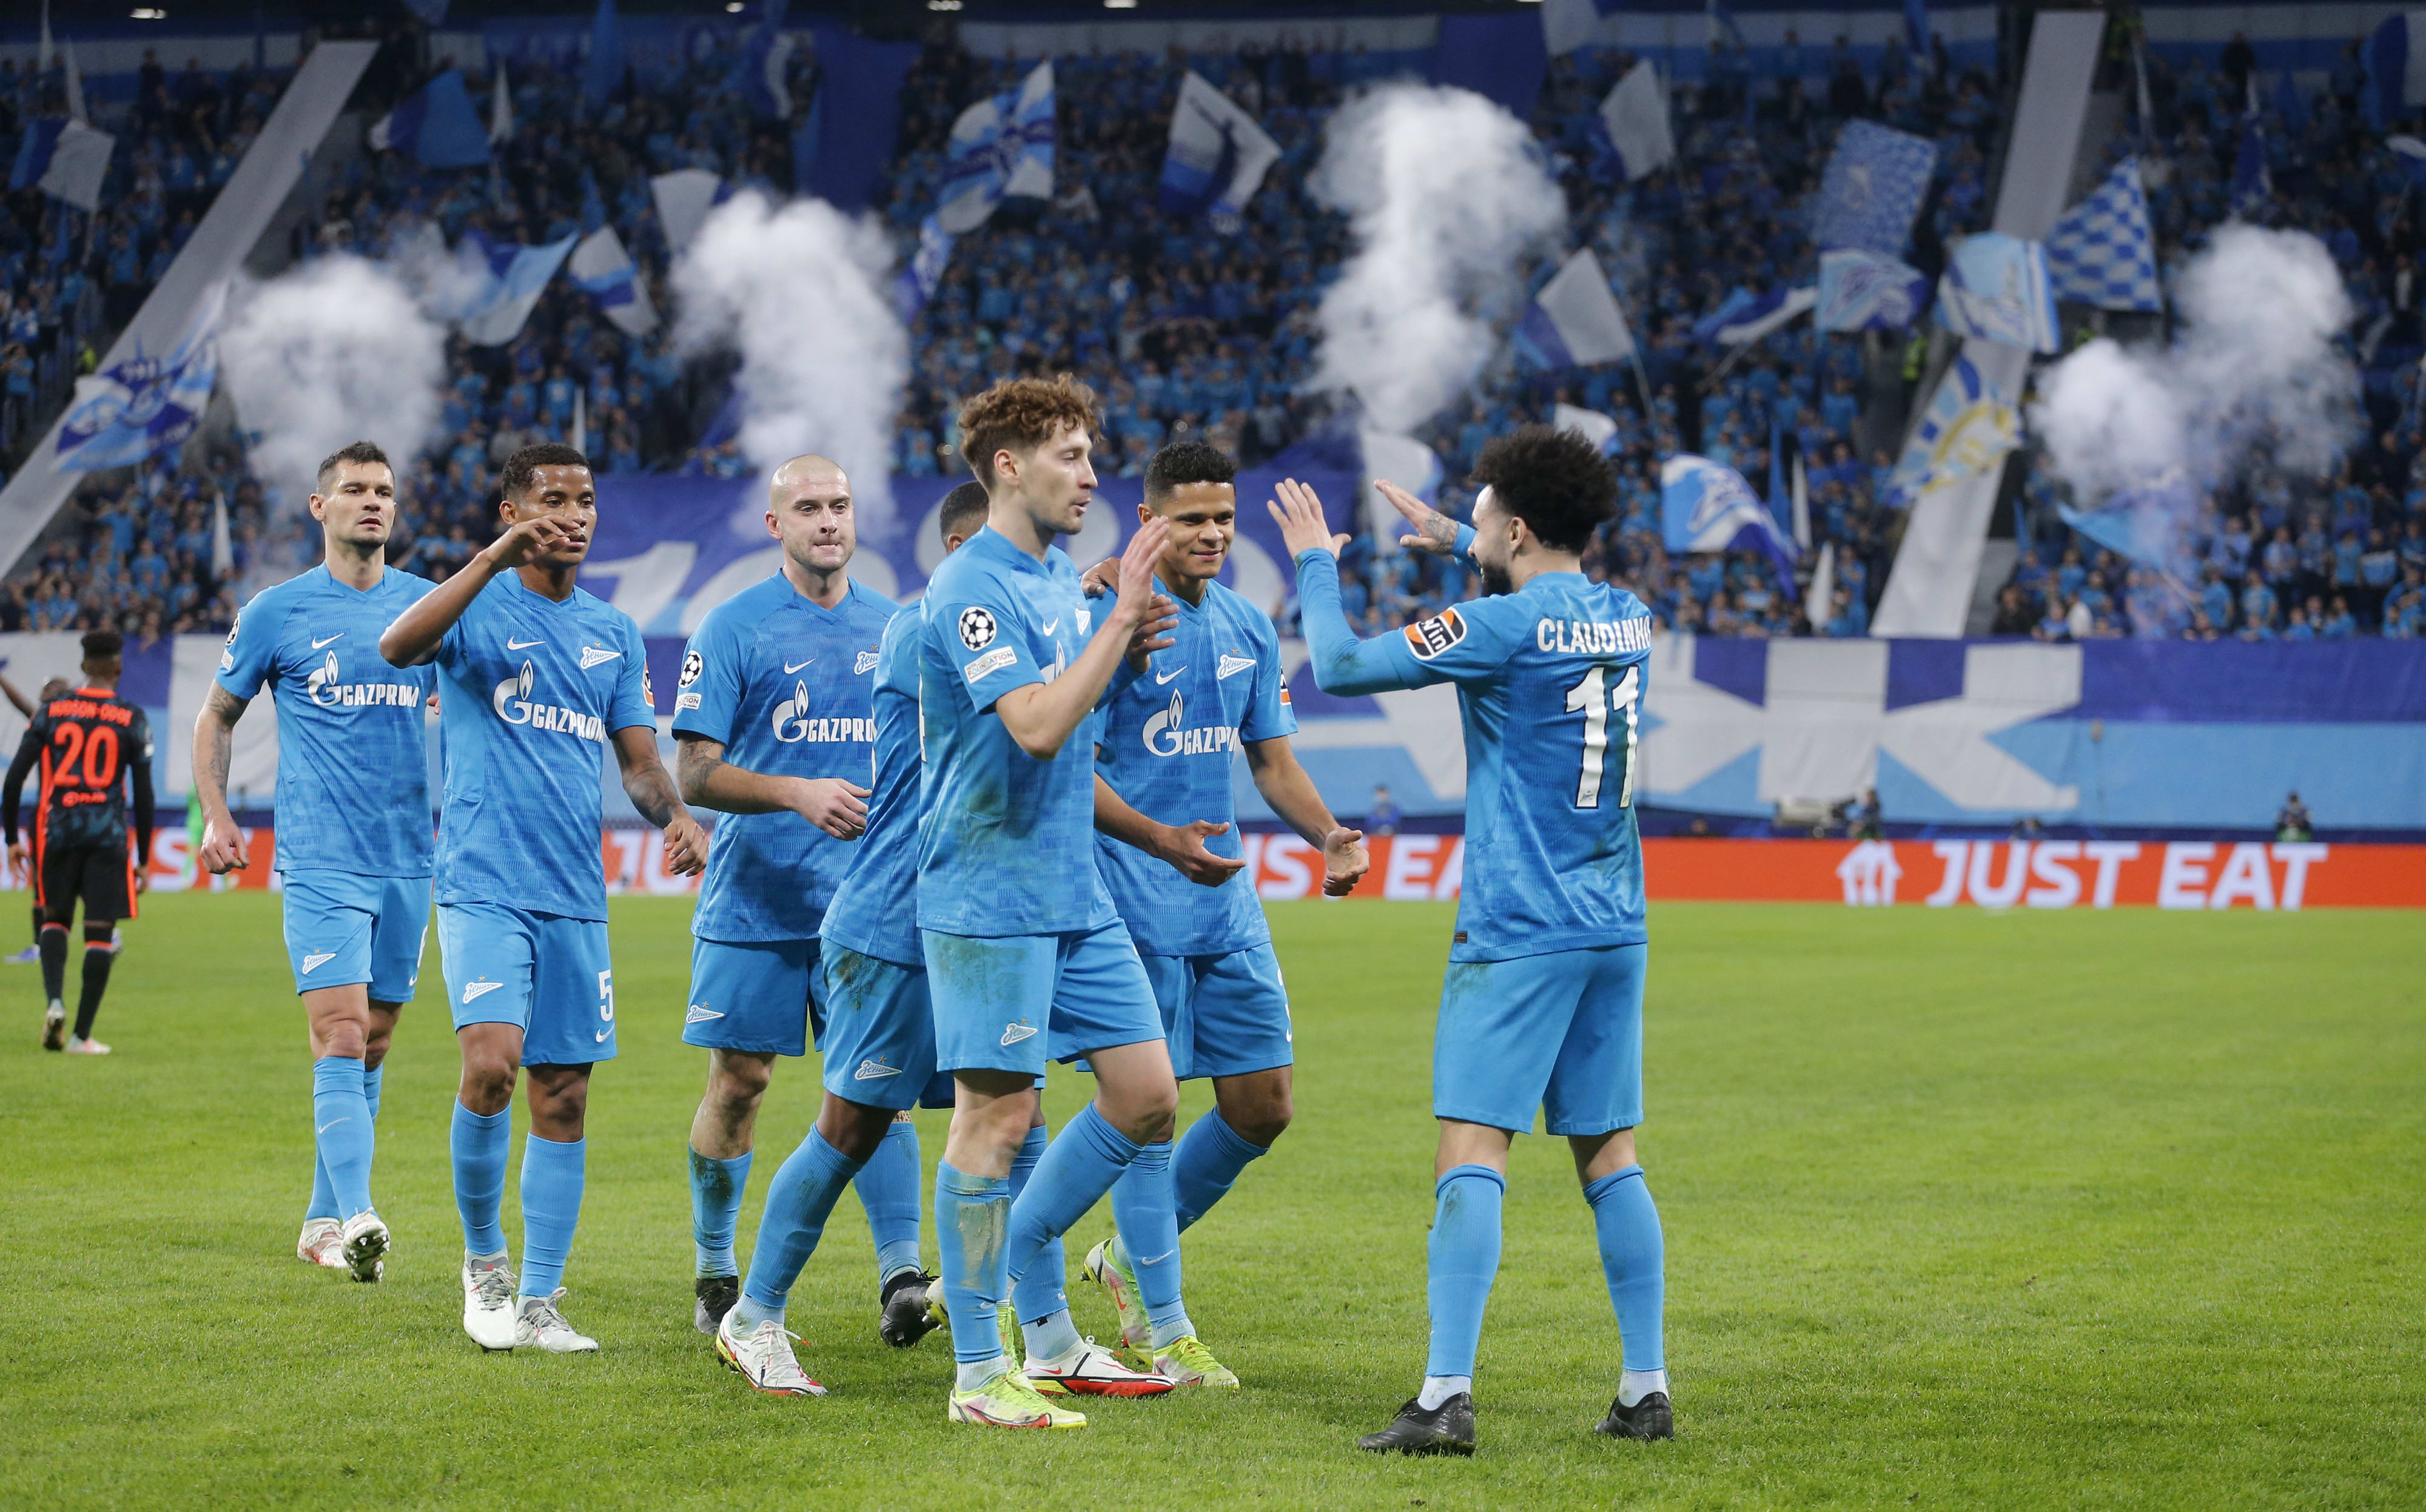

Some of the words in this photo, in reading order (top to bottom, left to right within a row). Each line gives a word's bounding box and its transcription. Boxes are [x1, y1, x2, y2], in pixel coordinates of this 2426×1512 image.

[1537, 615, 1651, 653] CLAUDINHO
[343, 684, 420, 708] GAZPROM
[53, 722, 119, 788] 20
[807, 718, 873, 742] GAZPRO
[1565, 666, 1639, 808] 11
[1925, 839, 2142, 909] JUST
[2157, 841, 2329, 912] EAT
[598, 969, 613, 1022] 5
